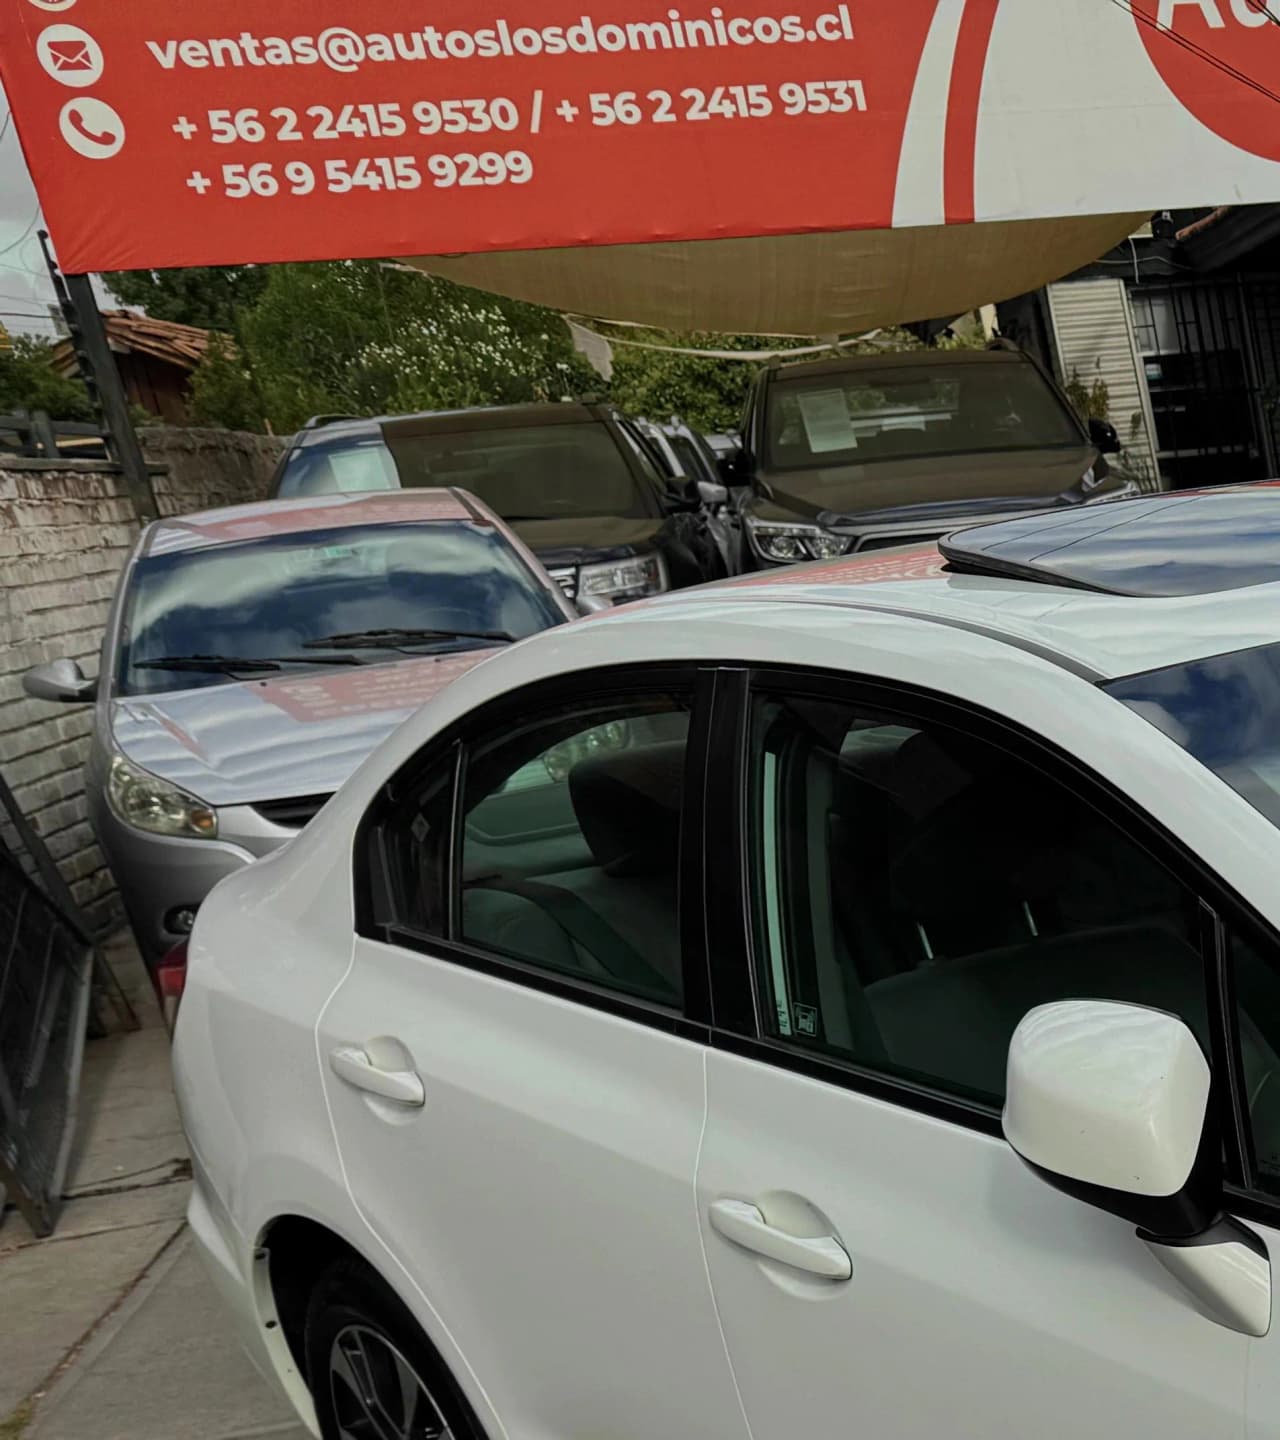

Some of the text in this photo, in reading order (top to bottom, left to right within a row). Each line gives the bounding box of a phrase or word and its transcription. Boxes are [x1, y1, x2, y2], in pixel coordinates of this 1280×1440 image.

[146, 5, 854, 73] ventas@autoslosdominicos.cl
[173, 79, 867, 144] + 56 2 2415 9530 / + 56 2 2415 9531
[187, 150, 533, 198] + 56 9 5415 9299
